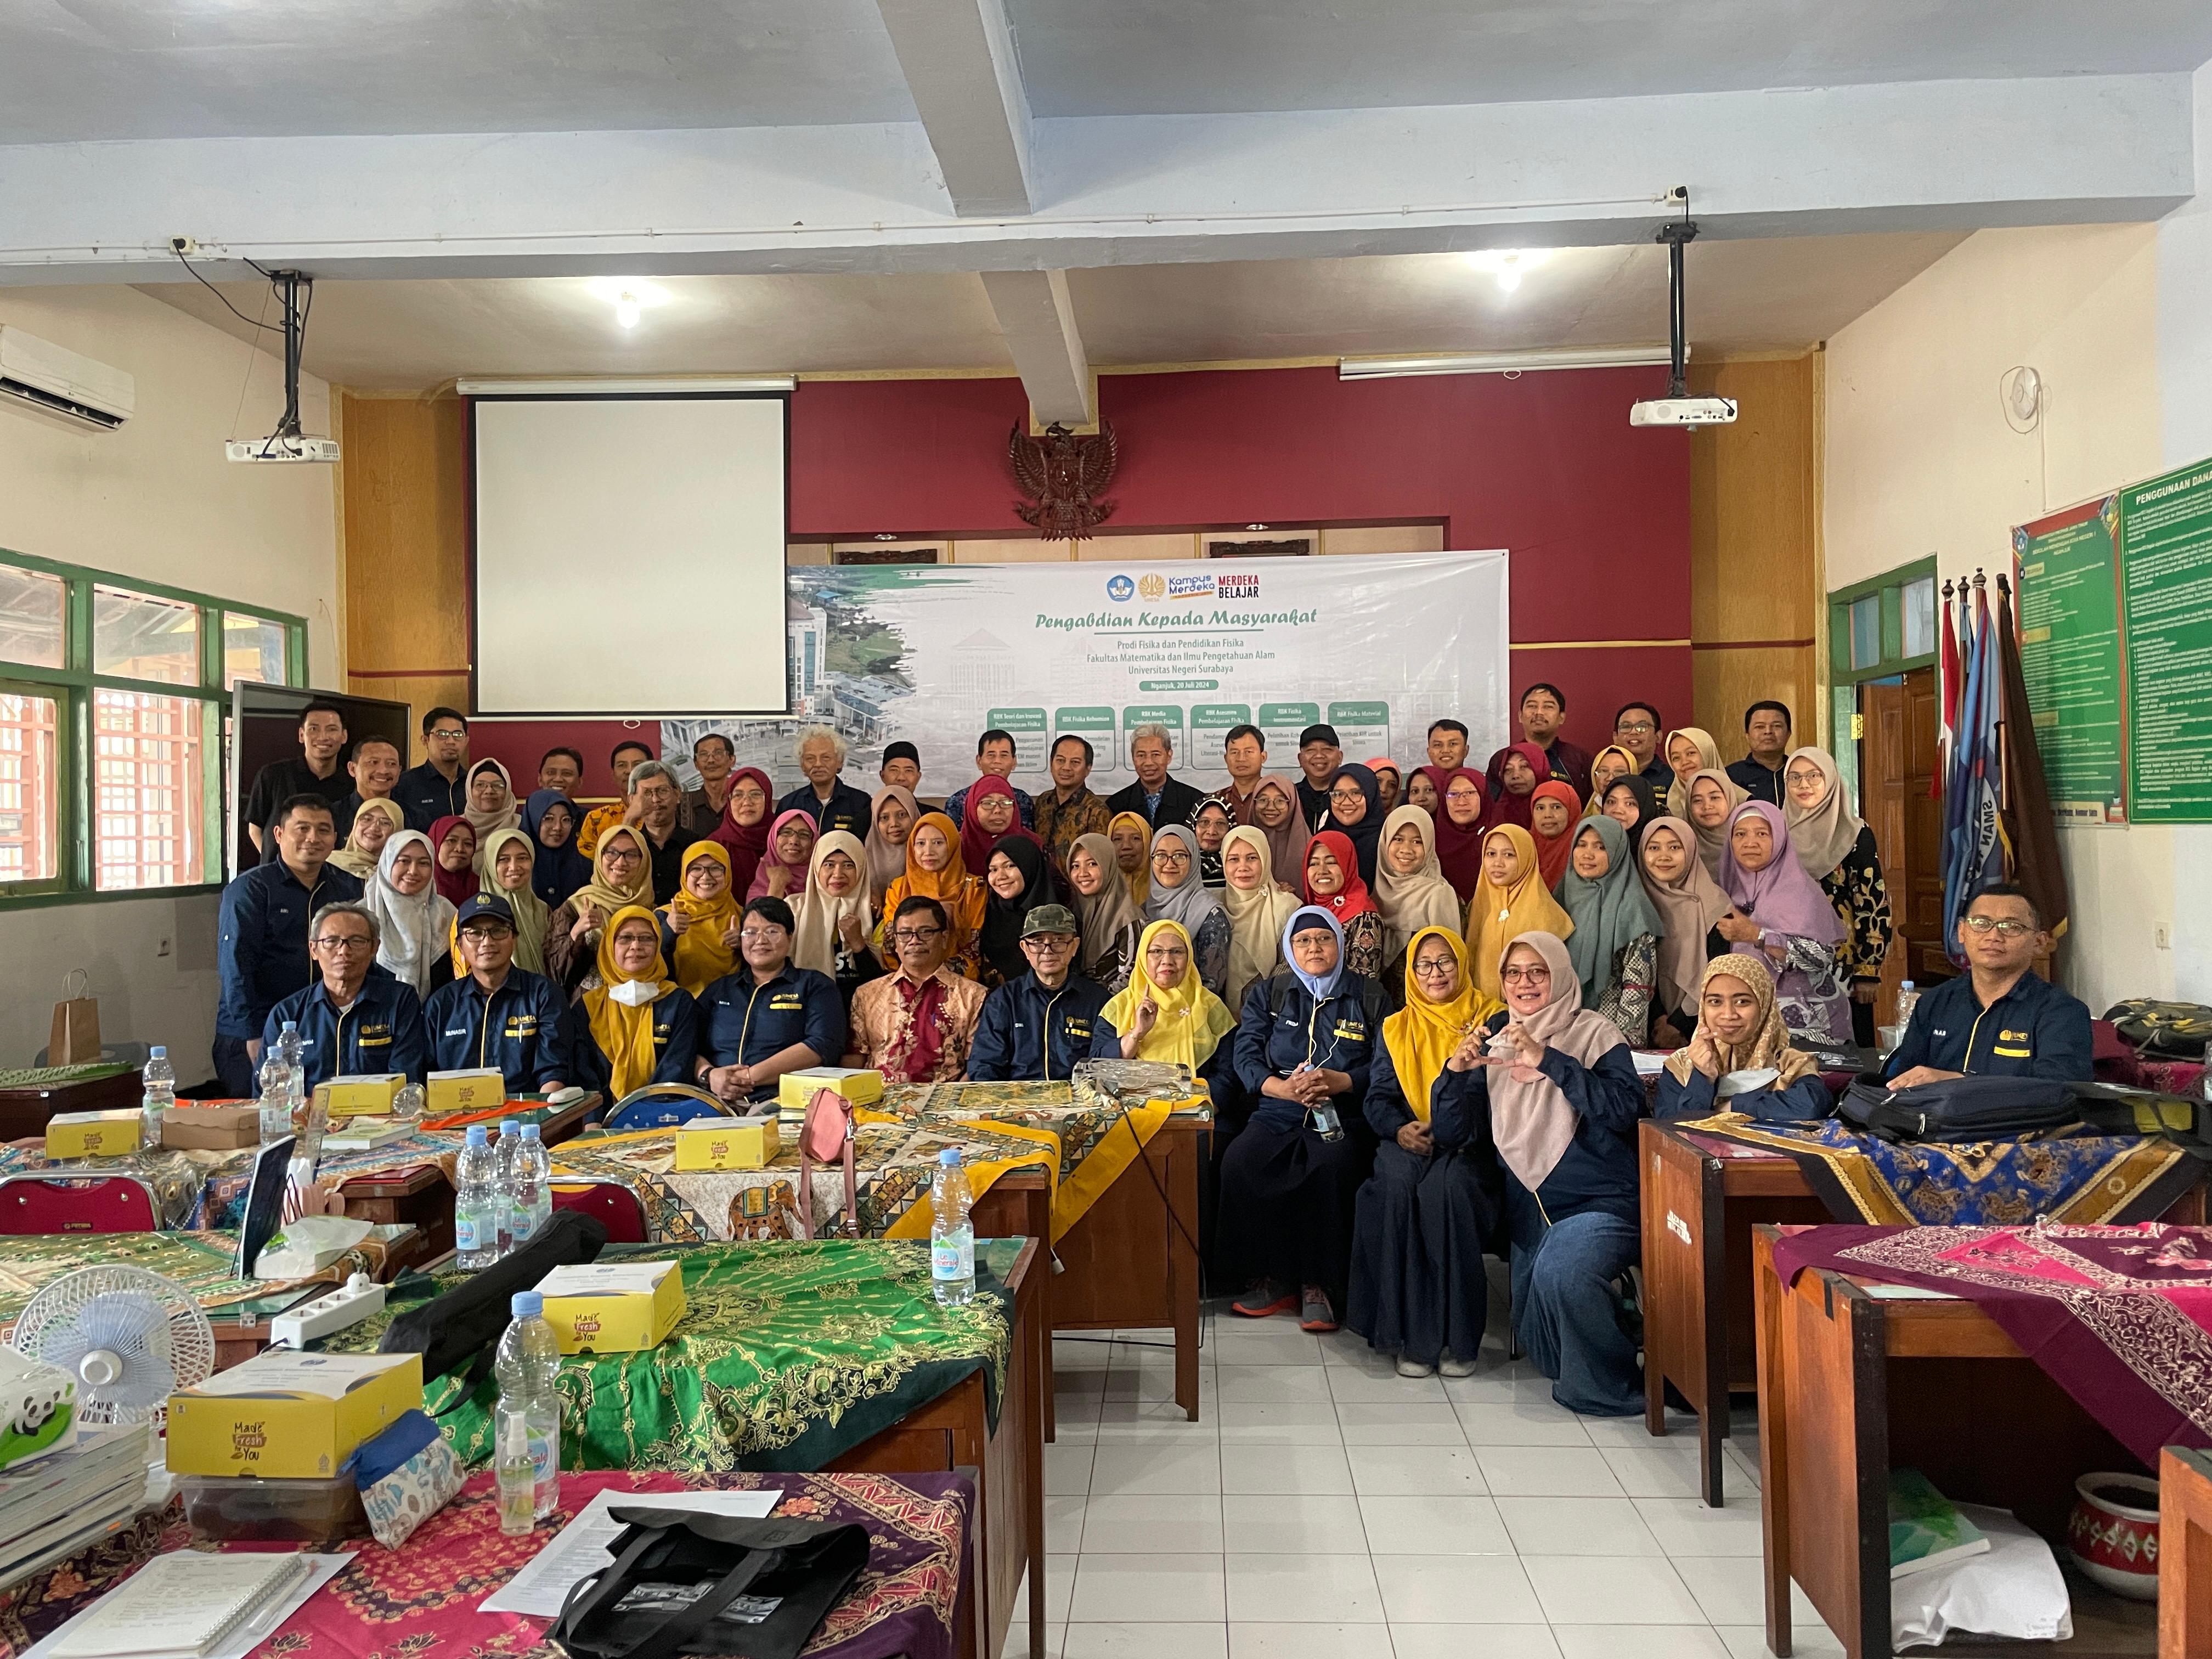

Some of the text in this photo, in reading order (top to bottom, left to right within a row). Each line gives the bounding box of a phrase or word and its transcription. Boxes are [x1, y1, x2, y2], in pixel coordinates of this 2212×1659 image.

[2136, 478, 2191, 506] PENGGUNAAN
[1169, 575, 1211, 586] Kampus
[1218, 575, 1259, 586] MERDEKA
[1169, 582, 1215, 595] Merdeka
[1219, 586, 1259, 599] BELAJAR
[1035, 609, 1317, 631] Pengabdian Kepada Masyarakat
[1118, 638, 1244, 650] Prodi Fisika dan Pendidikan Fisika
[1087, 651, 1275, 663] Fakultas Matematika dan Ilmu Pengetahuan Alam
[1128, 664, 1233, 676] Universitas Negeri Surabaya
[1151, 682, 1176, 690] Nganjuk,
[576, 1313, 597, 1322] Made
[576, 1322, 598, 1331] Fresh
[583, 1331, 596, 1341] You
[234, 1421, 262, 1433] Made
[235, 1434, 263, 1446] Fresh
[243, 1448, 259, 1461] You
